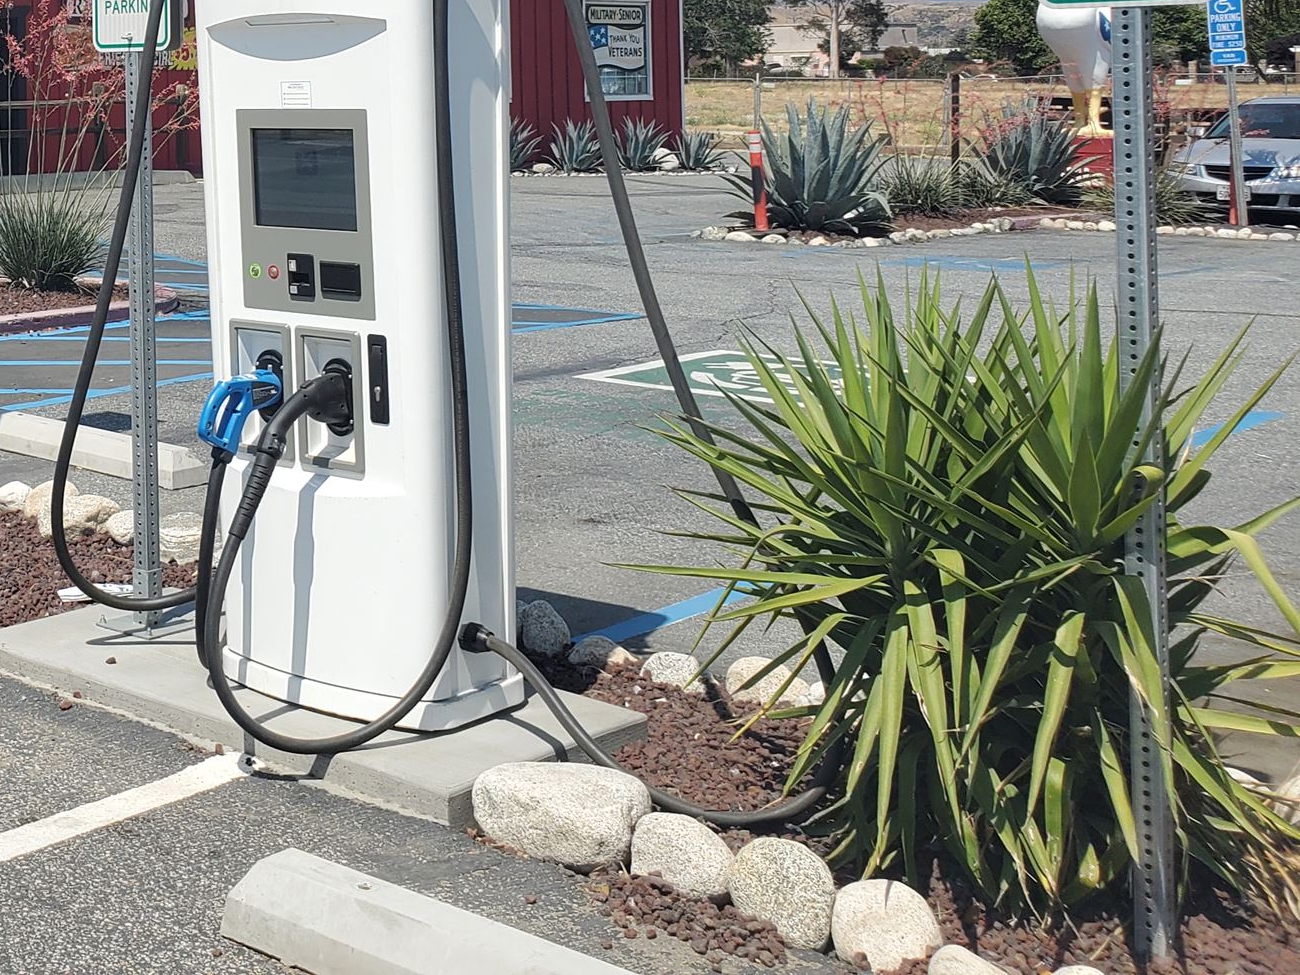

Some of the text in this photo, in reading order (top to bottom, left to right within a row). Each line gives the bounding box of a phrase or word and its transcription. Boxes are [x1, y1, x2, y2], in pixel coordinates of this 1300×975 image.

[1210, 12, 1241, 23] PARKING
[1216, 22, 1236, 32] ONLY
[609, 32, 640, 44] THANK YOU
[608, 47, 642, 58] VETERANS
